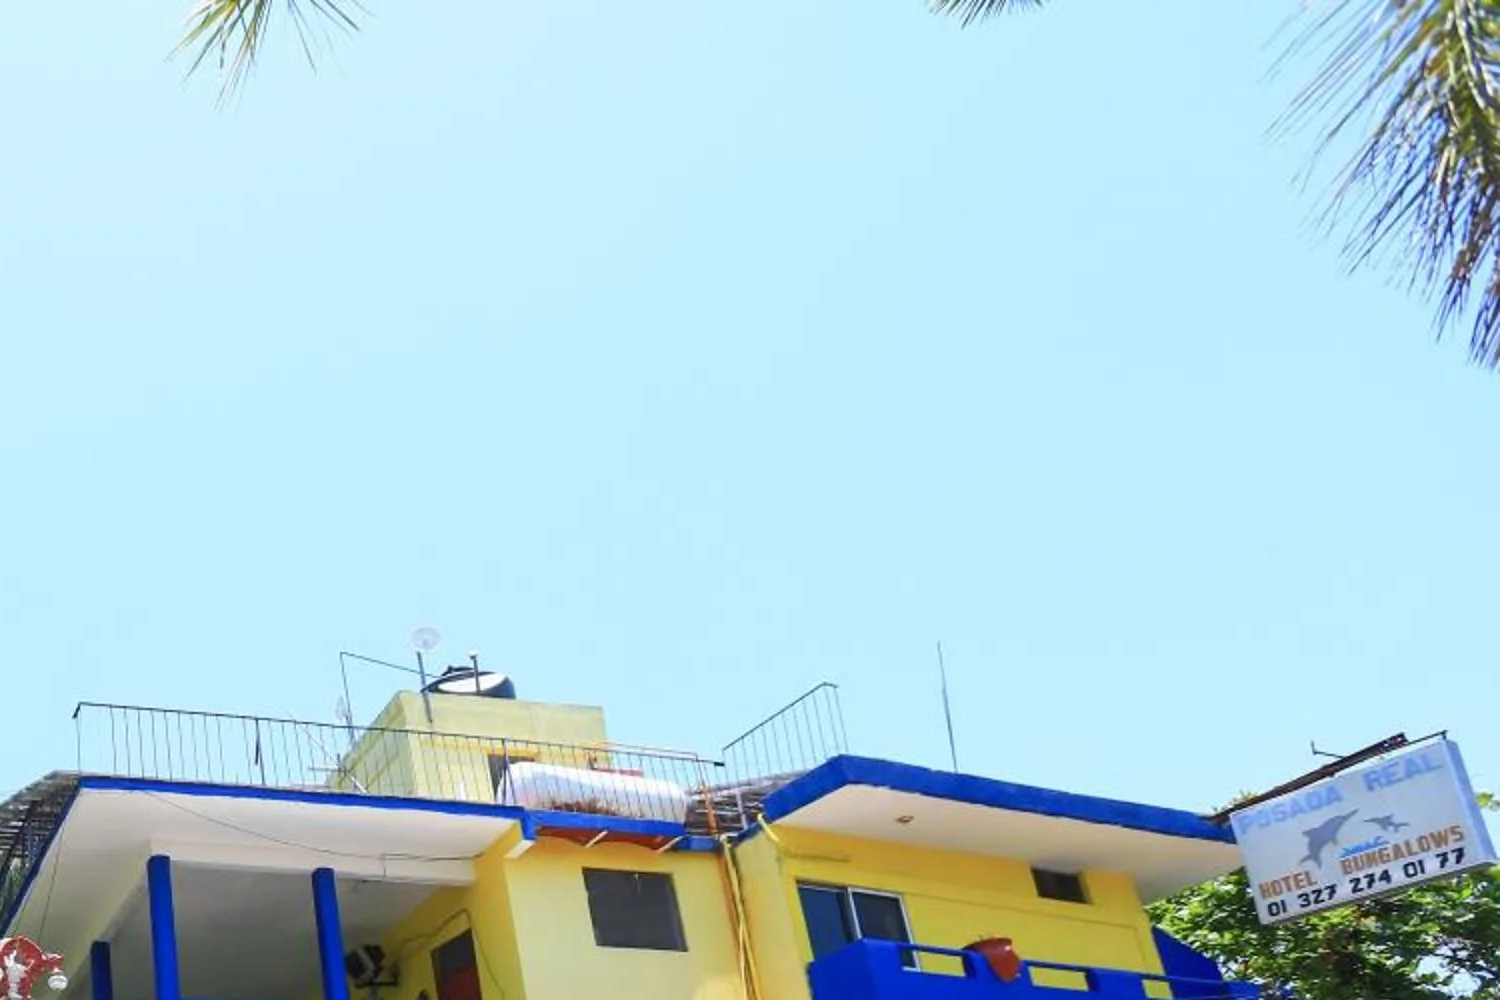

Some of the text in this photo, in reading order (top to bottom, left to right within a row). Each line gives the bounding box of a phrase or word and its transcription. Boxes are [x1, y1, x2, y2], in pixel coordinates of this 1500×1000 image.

[1238, 752, 1444, 834] POSADA REAL
[1258, 825, 1465, 900] HOTEL BUNGALOWS
[1297, 884, 1337, 908] 327
[1349, 869, 1392, 894] 274
[1435, 847, 1466, 869] 77
